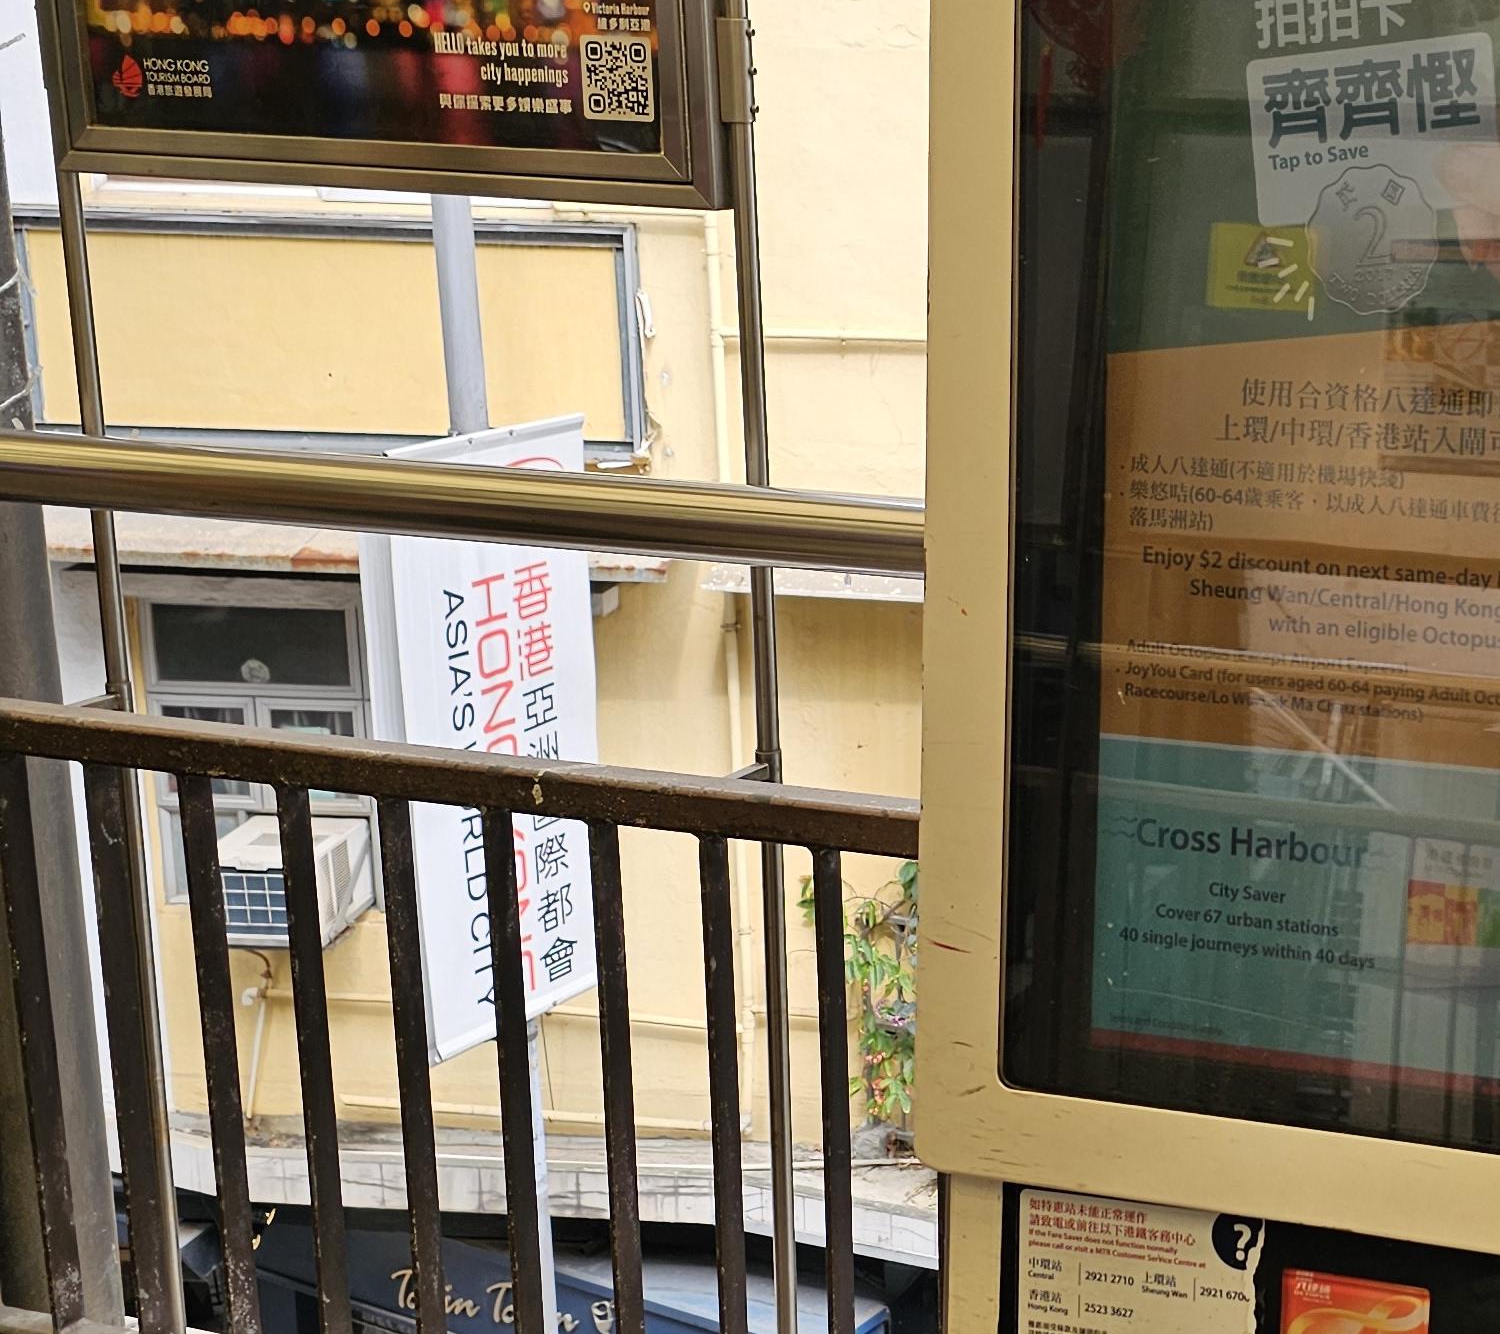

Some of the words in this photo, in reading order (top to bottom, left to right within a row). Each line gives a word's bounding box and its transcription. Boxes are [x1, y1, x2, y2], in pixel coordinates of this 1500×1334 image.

[433, 32, 465, 54] HELLO
[466, 37, 497, 57] takes
[500, 43, 519, 60] you
[522, 39, 535, 58] to
[537, 43, 567, 59] more
[143, 58, 176, 71] HONG
[177, 59, 210, 73] KONG
[146, 71, 180, 83] TOURISM
[181, 73, 211, 84] BOARD
[480, 62, 502, 85] city
[504, 63, 569, 88] happenings
[1261, 48, 1481, 148] 齊齊慳
[1268, 153, 1300, 172] Tap
[1304, 151, 1323, 166] to
[1327, 143, 1369, 163] Save
[1142, 545, 1195, 571] Enjoy
[1200, 549, 1222, 570] $2
[1228, 552, 1310, 575] discount
[1315, 561, 1340, 577] on
[1346, 562, 1390, 582] next
[1395, 566, 1493, 591] same-day
[1190, 578, 1262, 605] Sheung
[1267, 584, 1448, 618] Wan/Central/Hong
[1269, 614, 1311, 634] with
[1316, 621, 1339, 636] an
[1345, 621, 1418, 644] eligible
[443, 588, 477, 733] ASIA'S
[1125, 661, 1176, 680] JoyYou
[1179, 665, 1213, 682] Card
[1216, 669, 1242, 686] (for
[1245, 674, 1284, 687] users
[1287, 675, 1324, 694] aged
[1327, 678, 1370, 694] 60-64
[1373, 683, 1424, 703] paying
[1428, 688, 1471, 704] Adult
[1124, 682, 1230, 704] Racecourse/Lo
[1291, 696, 1313, 712] Ma
[1137, 818, 1221, 854] Cross
[1230, 827, 1368, 866] Harbour
[1209, 882, 1240, 901] City
[1243, 885, 1286, 904] Saver
[1156, 904, 1200, 922] Cover
[1203, 909, 1222, 924] 67
[1226, 912, 1273, 931] urban
[1276, 916, 1339, 937] stations
[1118, 927, 1138, 942] 40
[1142, 930, 1188, 949] single
[1190, 936, 1259, 958] journeys
[1262, 943, 1311, 962] within
[1315, 949, 1335, 964] 40
[1338, 951, 1376, 971] days
[1027, 1269, 1054, 1280] Central
[1085, 1270, 1108, 1283] 2921
[1110, 1273, 1134, 1286] 2710
[1142, 1285, 1170, 1298] Sheung
[1171, 1288, 1188, 1299] Wan
[1199, 1286, 1223, 1299] 2921
[1225, 1289, 1250, 1304] 670
[1027, 1302, 1048, 1313] Hong
[1049, 1304, 1069, 1316] Kong
[1084, 1302, 1108, 1315] 2523
[1110, 1305, 1134, 1318] 3627
